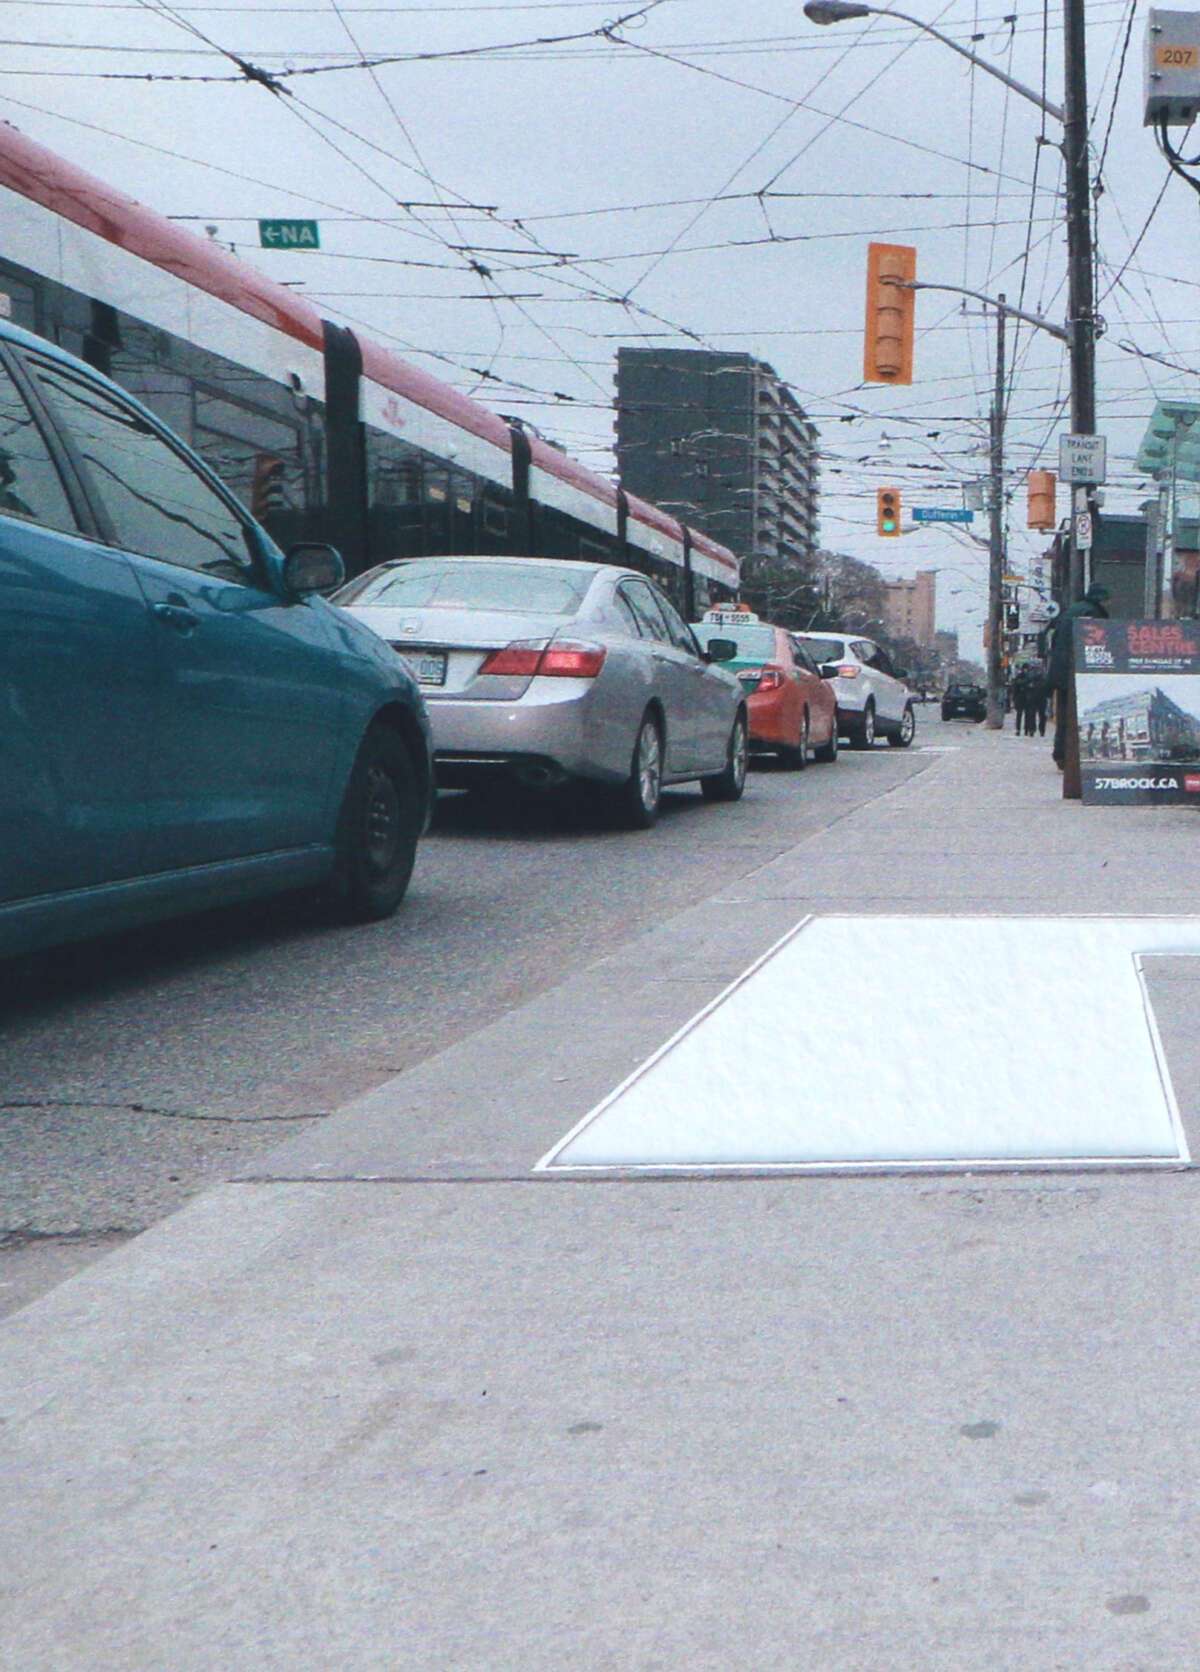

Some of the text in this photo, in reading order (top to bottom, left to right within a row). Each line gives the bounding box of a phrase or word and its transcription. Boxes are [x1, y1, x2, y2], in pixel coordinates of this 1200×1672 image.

[1163, 49, 1193, 65] 207
[1127, 625, 1183, 641] SALES
[1128, 639, 1199, 656] CENTRE
[1094, 777, 1179, 790] 57BROCK.CA
